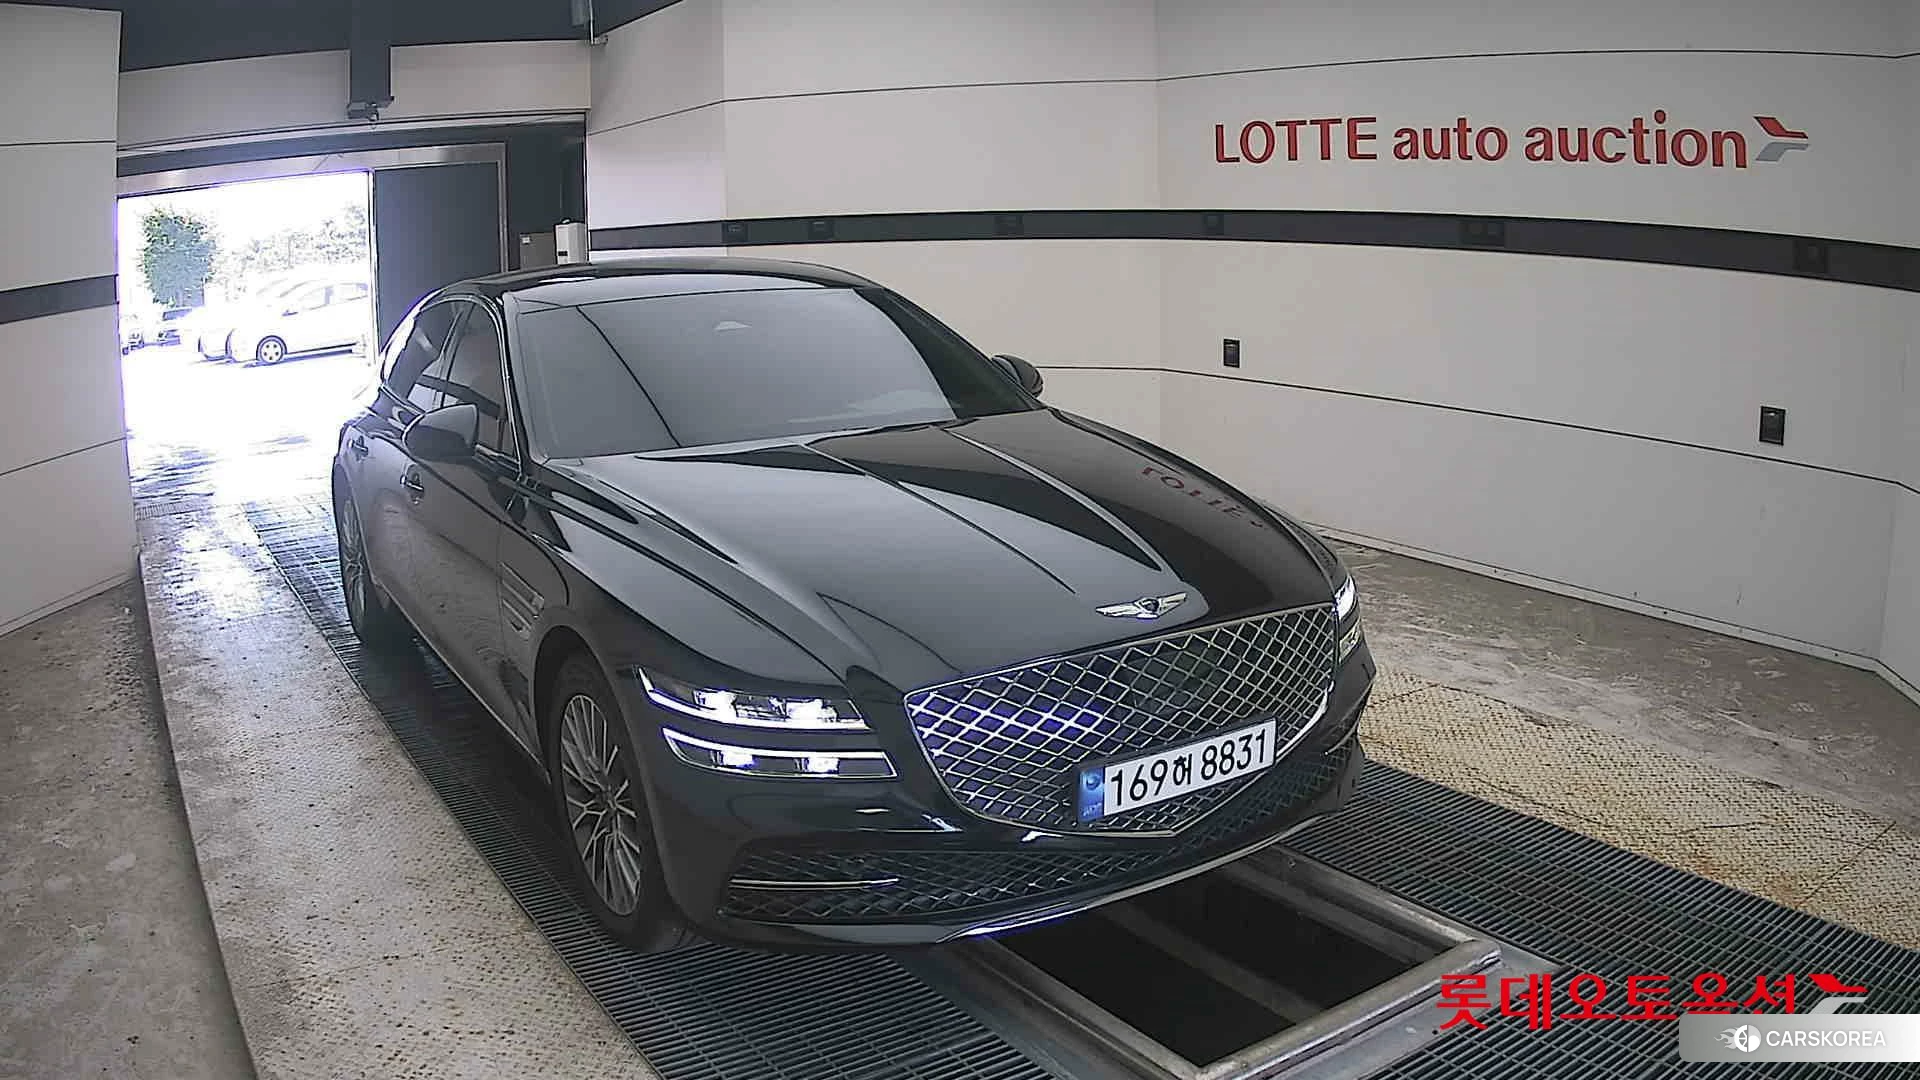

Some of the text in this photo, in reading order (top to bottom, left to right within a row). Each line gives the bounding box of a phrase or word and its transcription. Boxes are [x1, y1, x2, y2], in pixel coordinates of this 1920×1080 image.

[1214, 110, 1748, 168] LOTTE auto auction
[1111, 728, 1266, 806] 169허 8831
